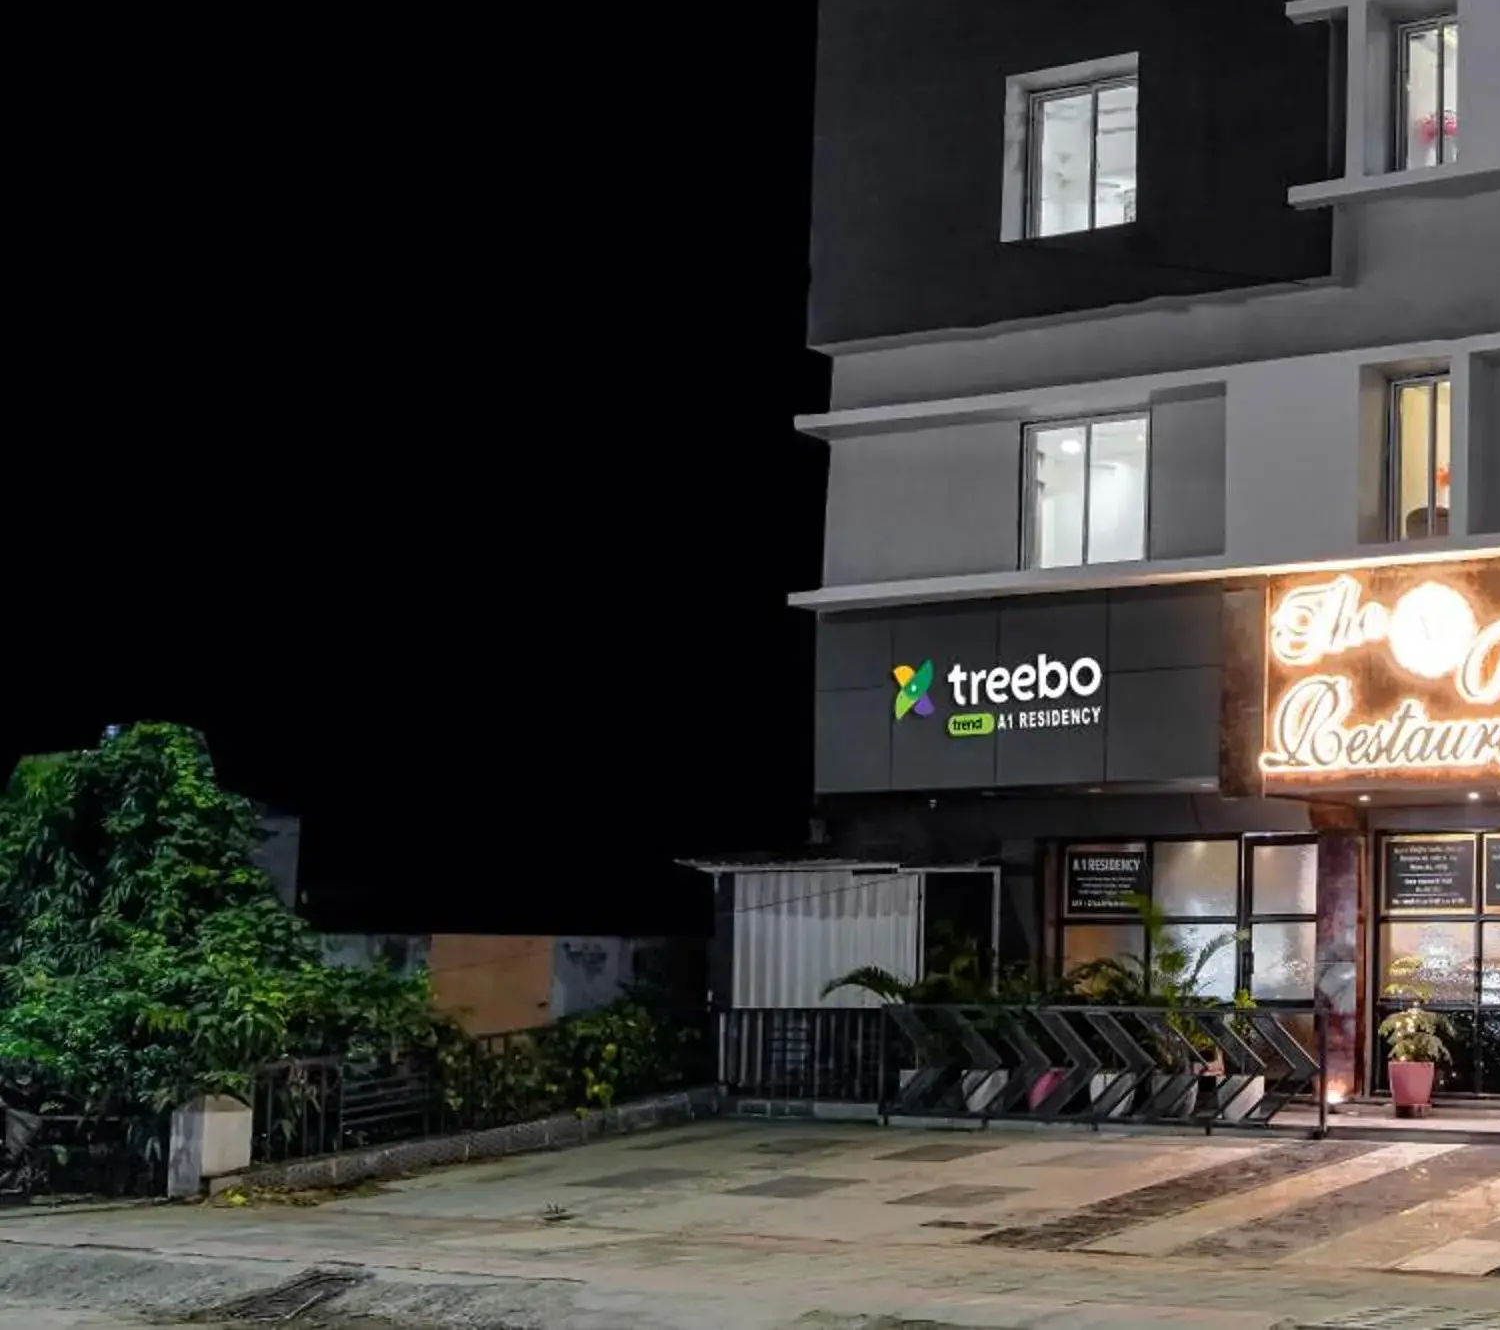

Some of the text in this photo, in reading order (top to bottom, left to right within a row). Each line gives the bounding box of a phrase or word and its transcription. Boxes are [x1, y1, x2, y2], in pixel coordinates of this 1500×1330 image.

[947, 653, 1102, 706] treebo
[952, 717, 984, 731] trend
[997, 706, 1102, 730] A1 RESIDENCY
[1087, 856, 1141, 871] RESIDENCY
